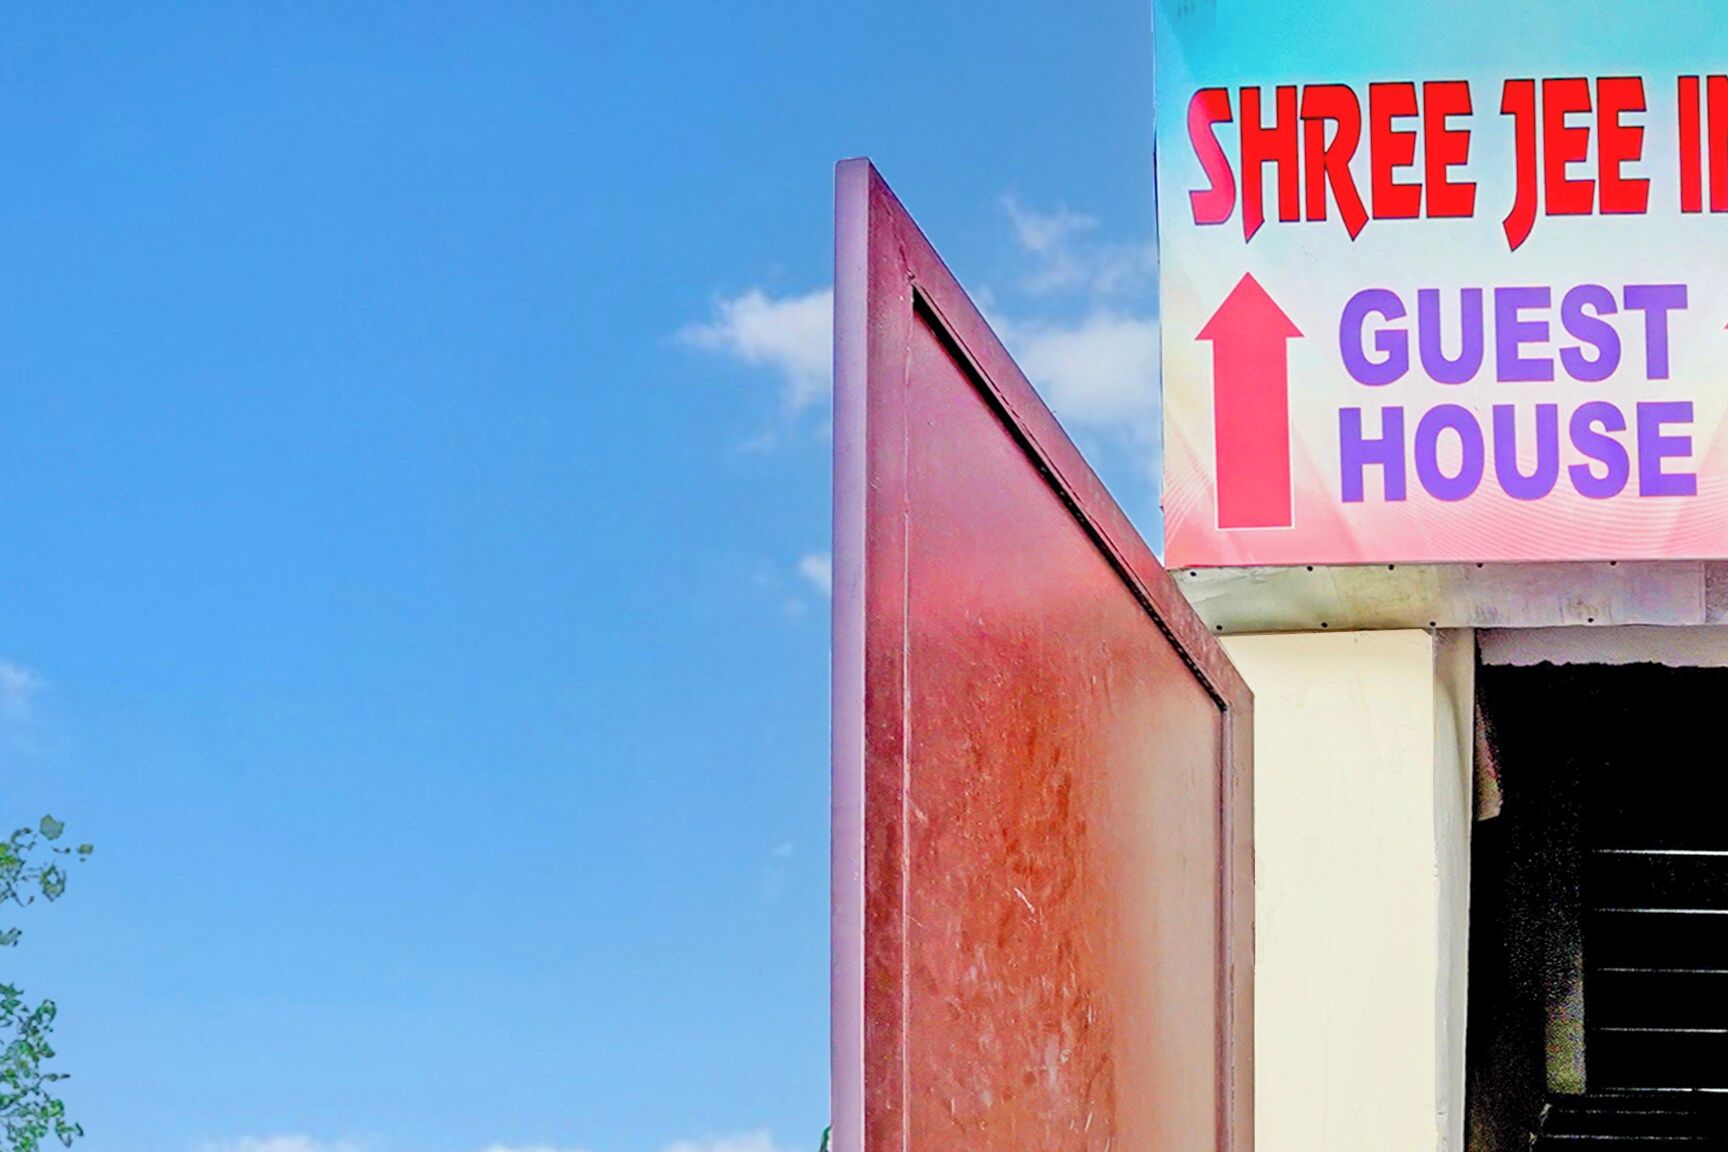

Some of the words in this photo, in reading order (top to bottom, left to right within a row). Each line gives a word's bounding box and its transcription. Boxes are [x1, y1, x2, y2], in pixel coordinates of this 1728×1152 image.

[1186, 78, 1478, 243] SHREE
[1500, 76, 1650, 253] JEE
[1338, 283, 1689, 386] GUEST
[1338, 400, 1698, 503] HOUSE
